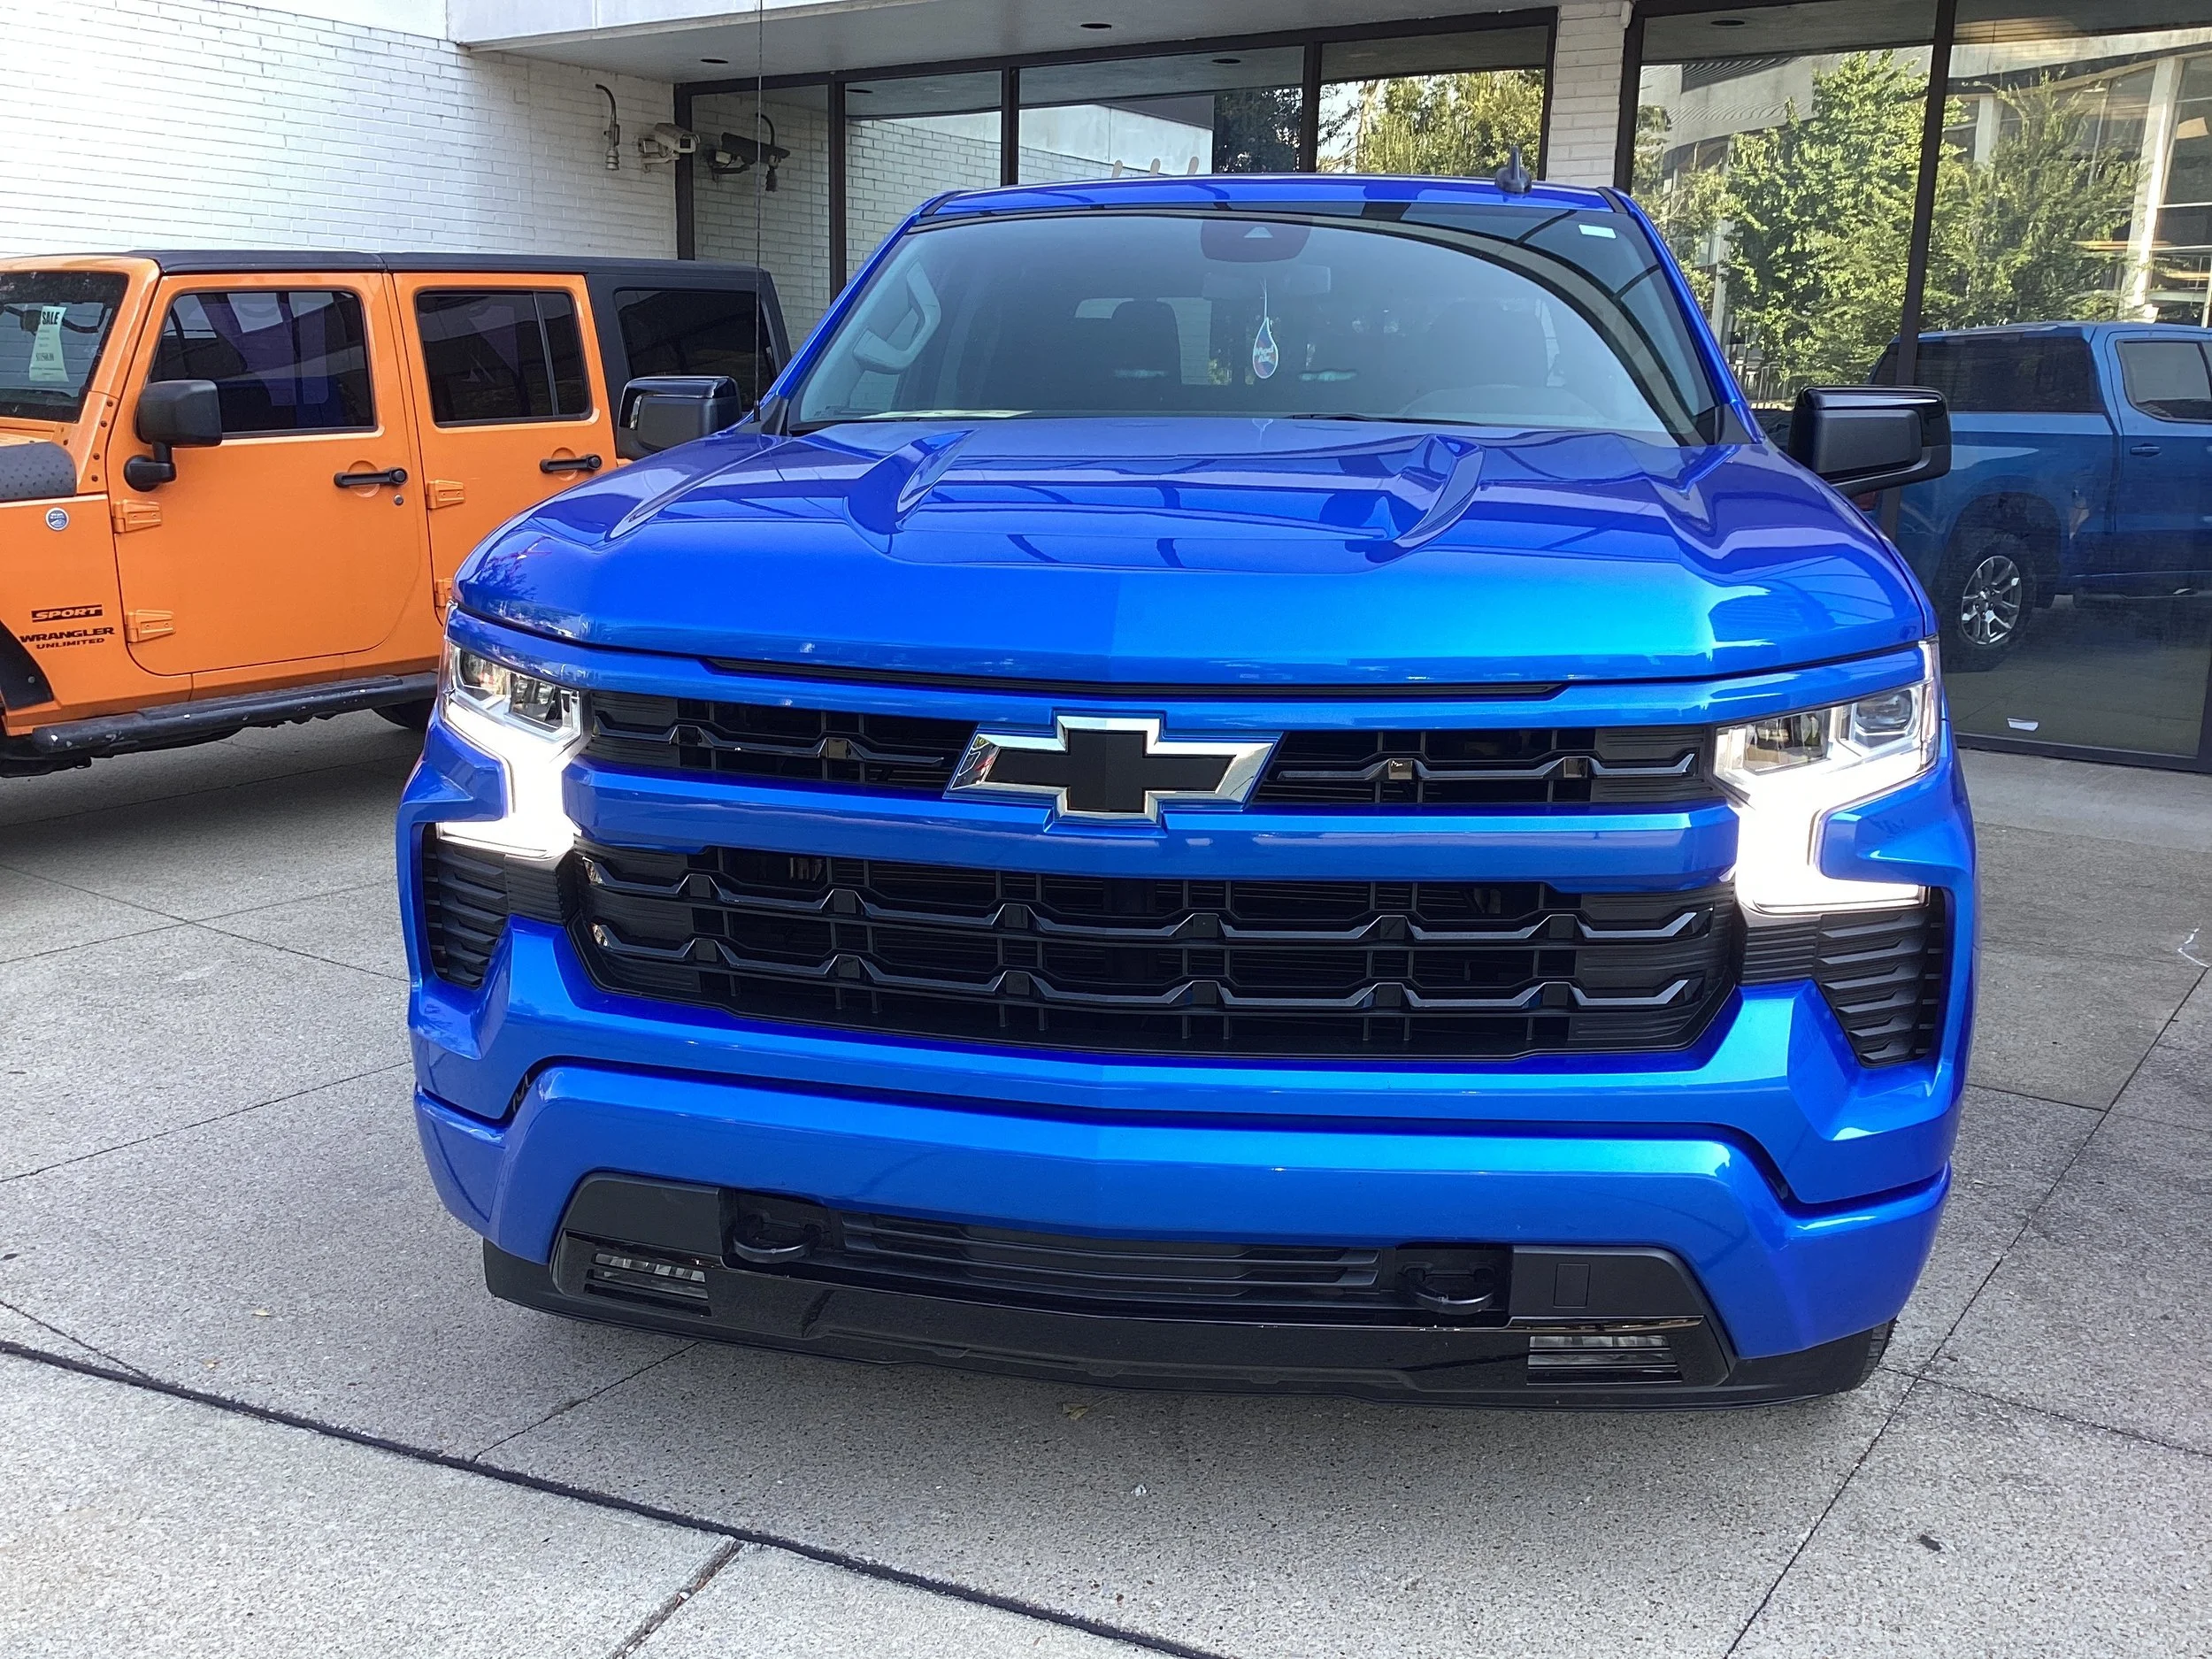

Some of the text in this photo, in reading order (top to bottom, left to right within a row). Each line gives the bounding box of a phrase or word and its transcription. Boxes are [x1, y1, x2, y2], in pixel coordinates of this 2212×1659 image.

[42, 311, 60, 325] SALE
[35, 608, 96, 619] SPORT
[19, 627, 115, 642] WRANGLER
[36, 638, 105, 649] UNLIMITED
